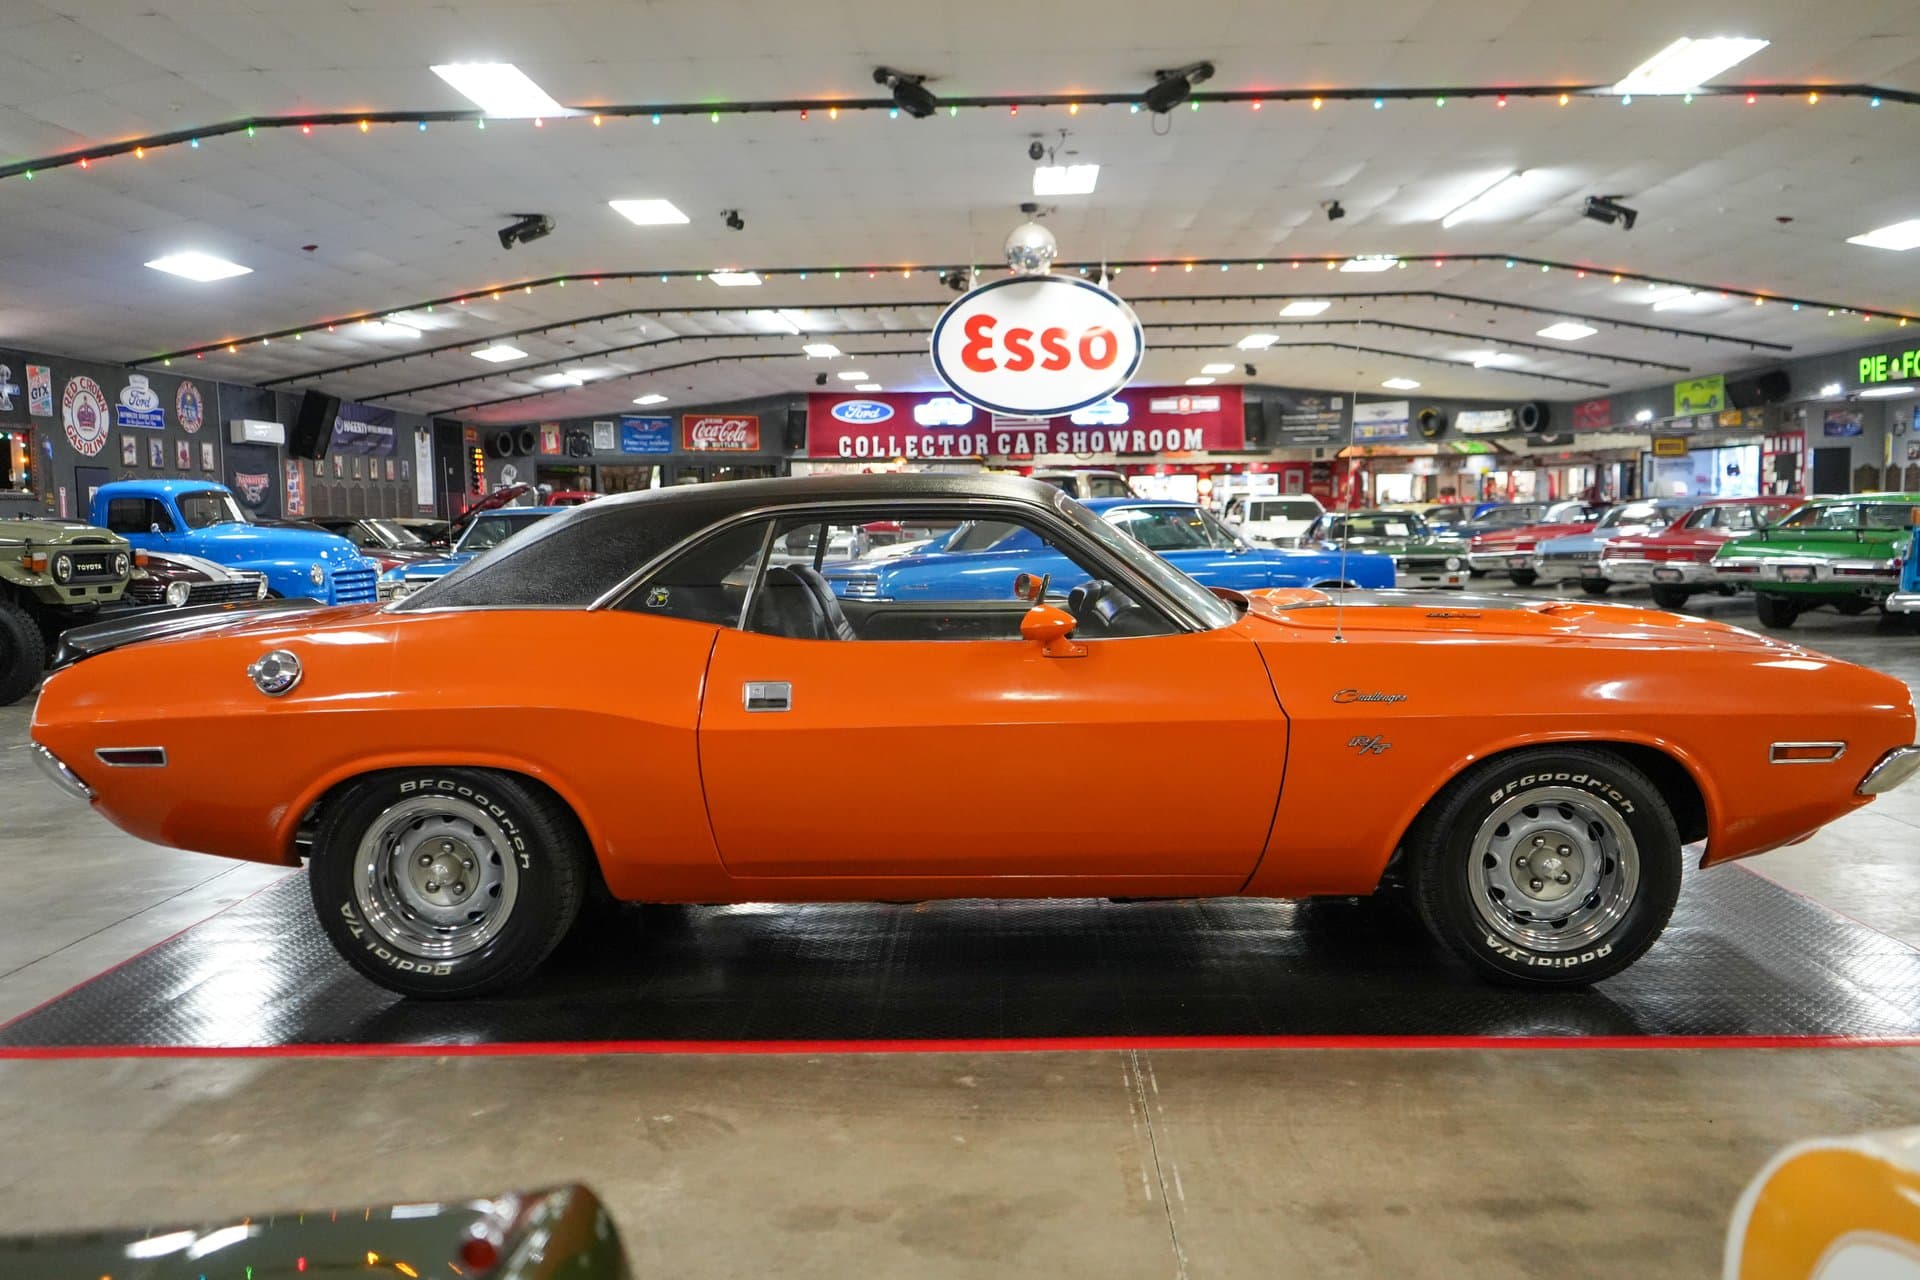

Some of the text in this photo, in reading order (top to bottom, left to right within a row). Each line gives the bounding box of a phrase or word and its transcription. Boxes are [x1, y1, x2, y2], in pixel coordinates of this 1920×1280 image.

[1859, 355, 1888, 384] PIE
[64, 378, 108, 412] RED CROWN
[129, 389, 152, 408] Ford
[844, 402, 881, 420] Ford
[66, 425, 107, 455] GASOLINE
[838, 427, 1204, 458] COLLECTOR CAR SHOWROOM
[76, 563, 103, 571] TOYOTA
[1489, 772, 1636, 814] BFGoodrich
[399, 778, 530, 870] BFGoodrich
[340, 900, 453, 977] Radial T/A
[1485, 934, 1613, 969] Radial T/A
